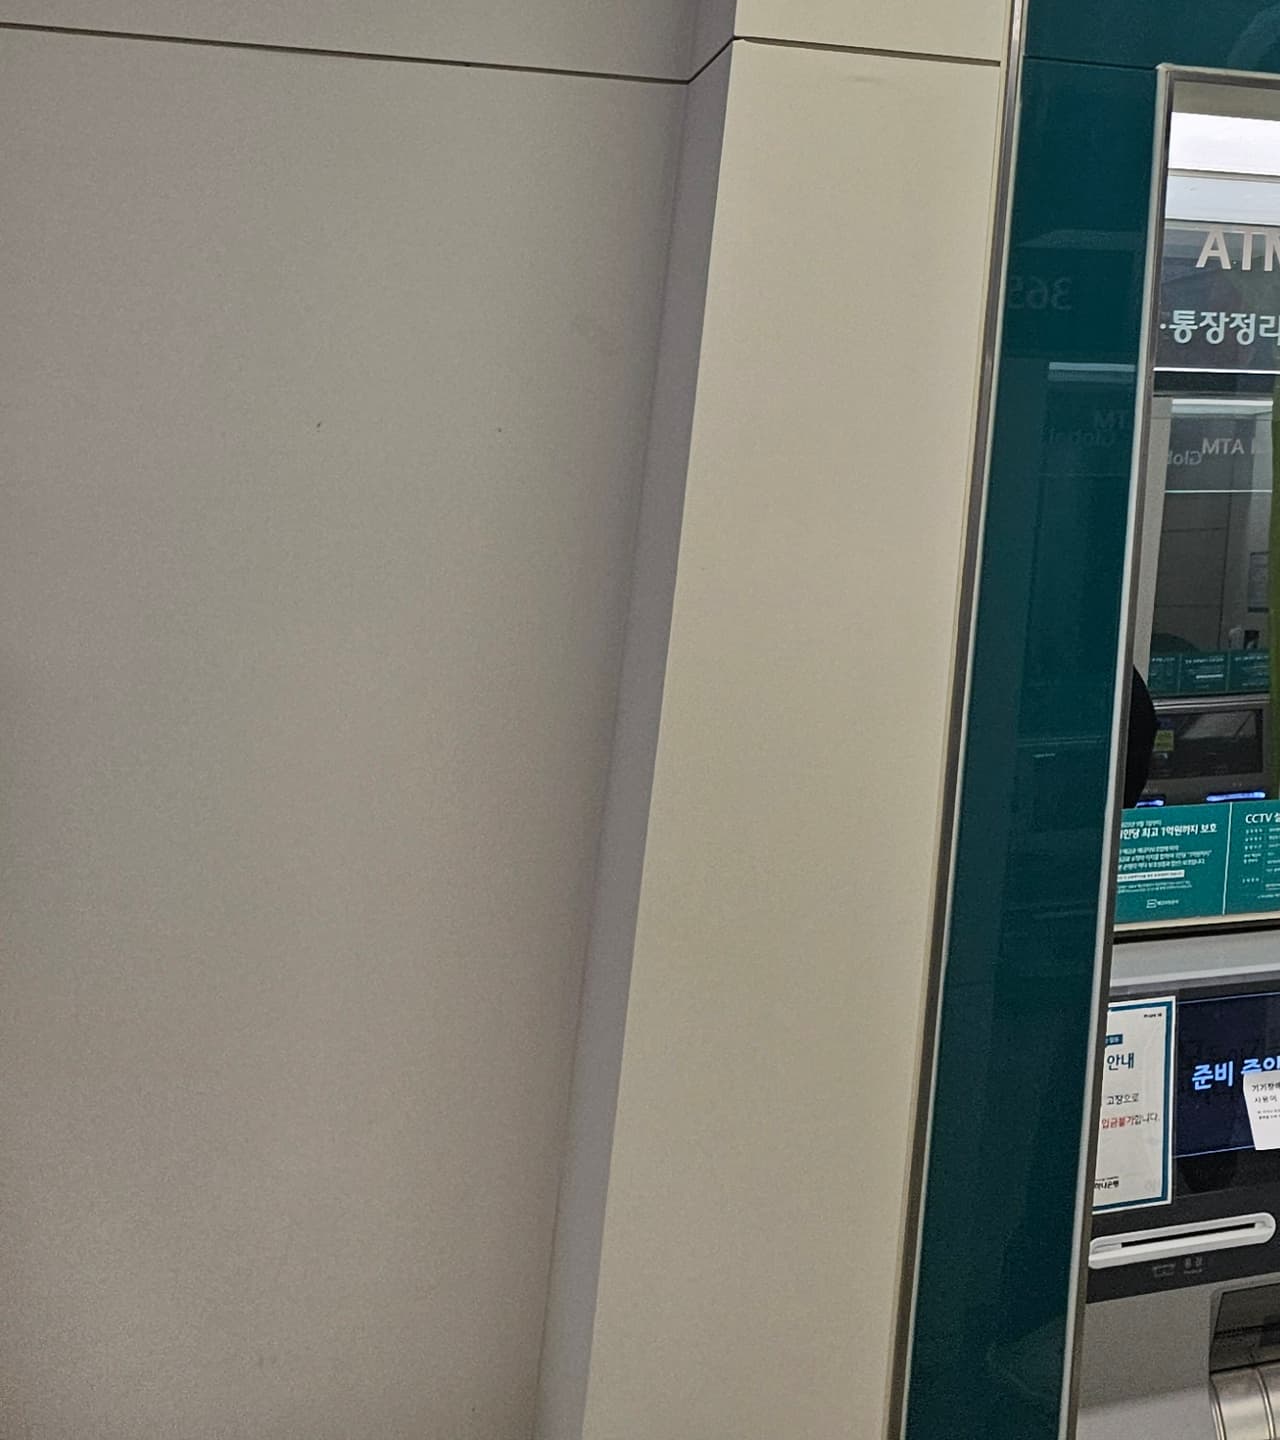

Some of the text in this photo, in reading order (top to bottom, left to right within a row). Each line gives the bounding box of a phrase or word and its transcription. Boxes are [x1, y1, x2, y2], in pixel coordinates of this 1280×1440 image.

[1245, 813, 1273, 824] CCTV
[1107, 1052, 1135, 1071] 안내
[1192, 1060, 1234, 1090] 준비
